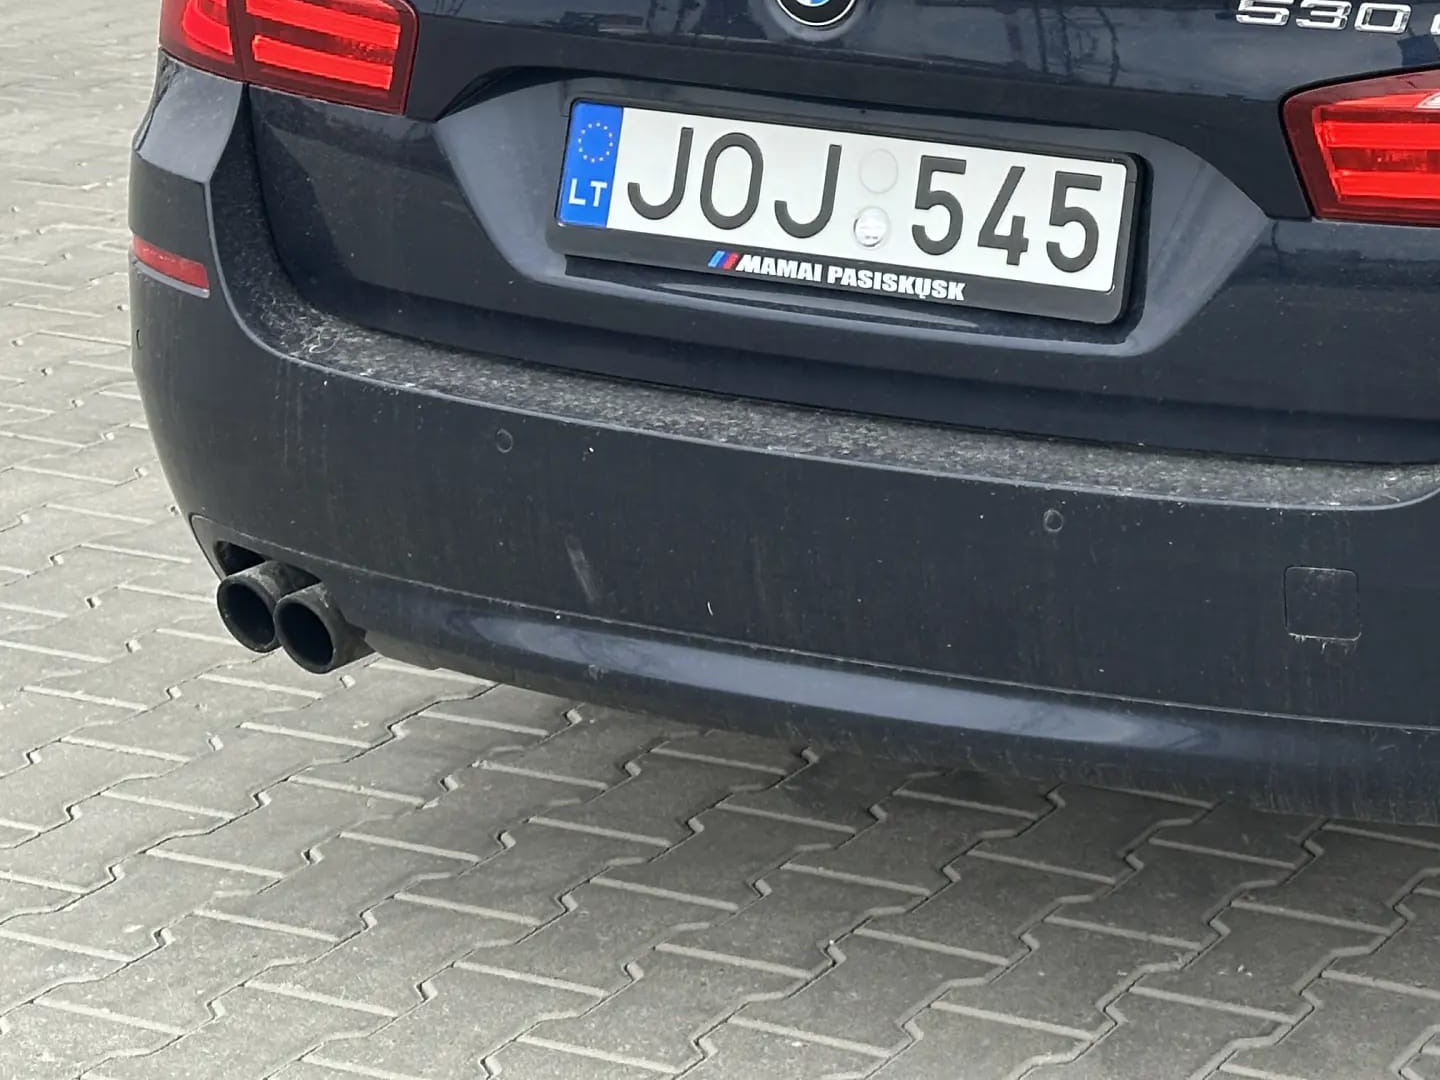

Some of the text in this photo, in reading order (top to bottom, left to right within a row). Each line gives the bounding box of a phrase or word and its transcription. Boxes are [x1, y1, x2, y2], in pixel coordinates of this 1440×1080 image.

[568, 177, 607, 207] LT
[627, 126, 1102, 273] JOJ 545
[736, 254, 822, 282] MAMAI
